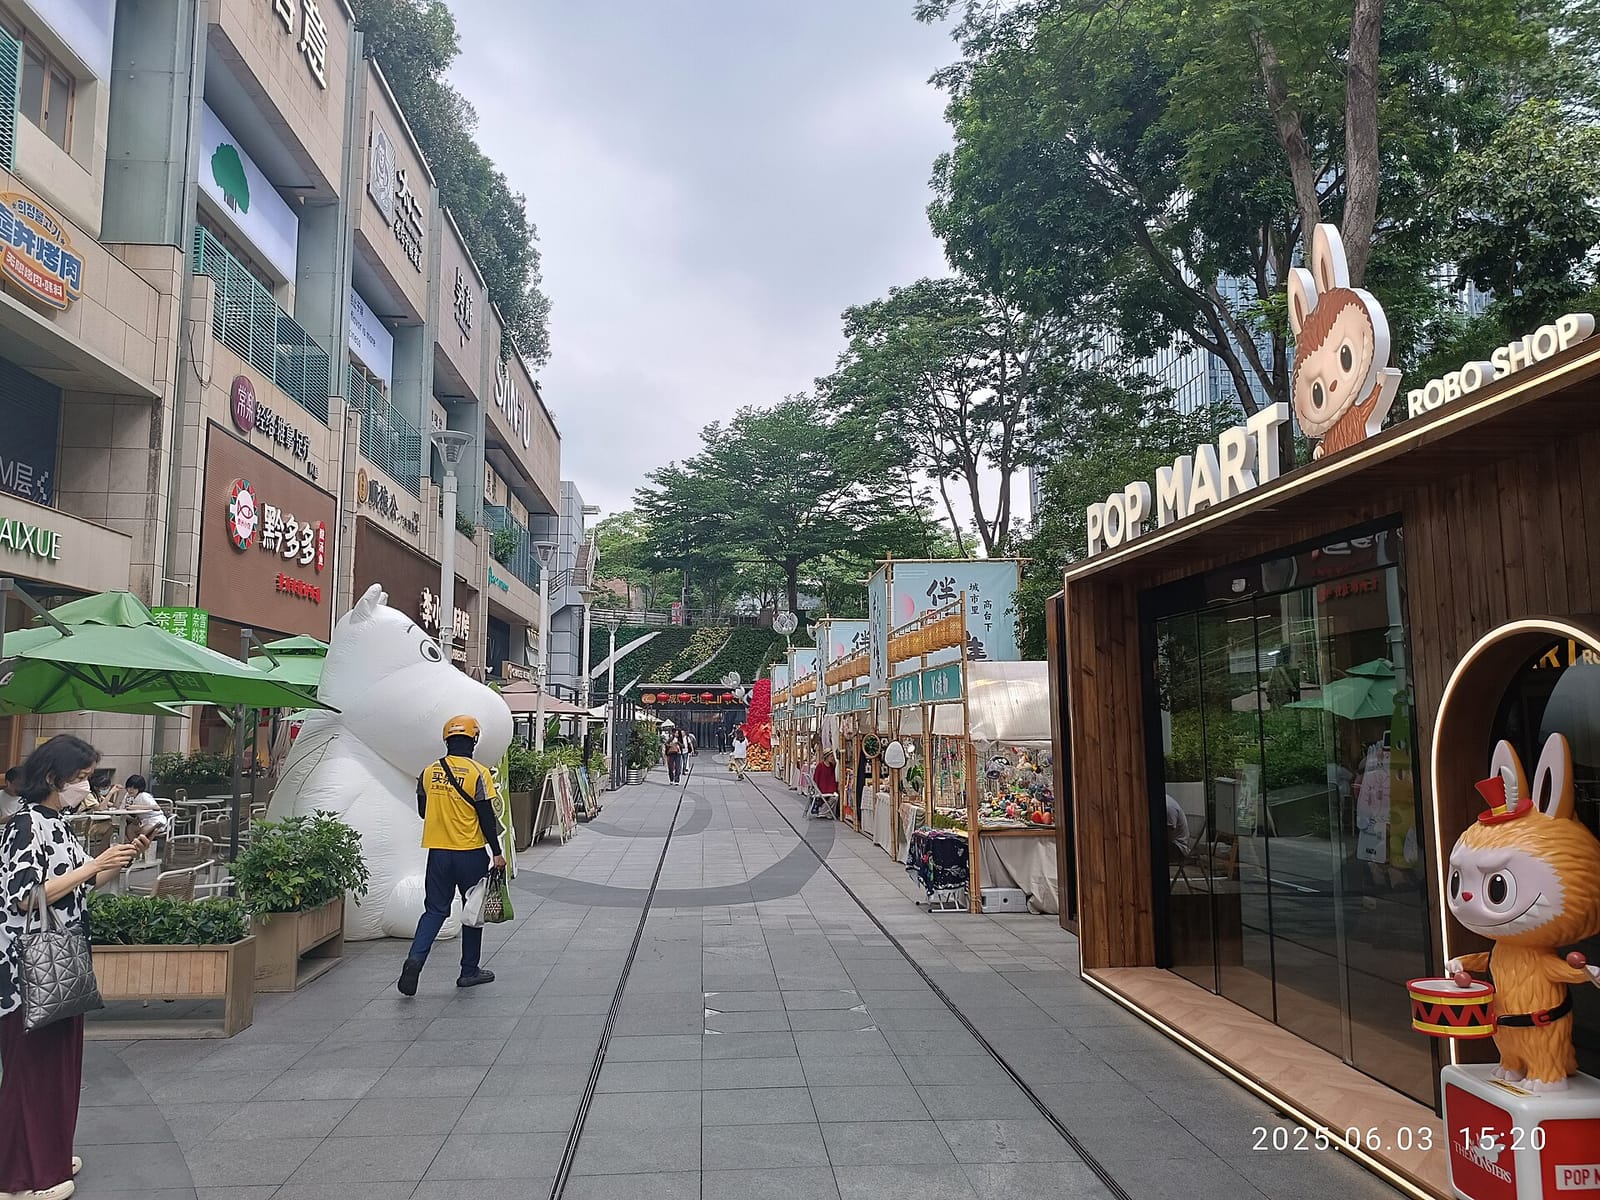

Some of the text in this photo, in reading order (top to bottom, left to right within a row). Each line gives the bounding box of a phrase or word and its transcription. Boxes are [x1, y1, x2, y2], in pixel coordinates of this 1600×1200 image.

[1407, 312, 1595, 420] ROBO SHOP
[1086, 402, 1289, 557] POP MART
[261, 503, 316, 566] 黔多多
[926, 576, 957, 606] 伴
[968, 582, 980, 615] 城市里
[154, 611, 188, 627] 奈雪
[983, 599, 993, 632] 高台下
[1468, 1147, 1512, 1184] MONSTERS
[1563, 1168, 1590, 1187] POP
